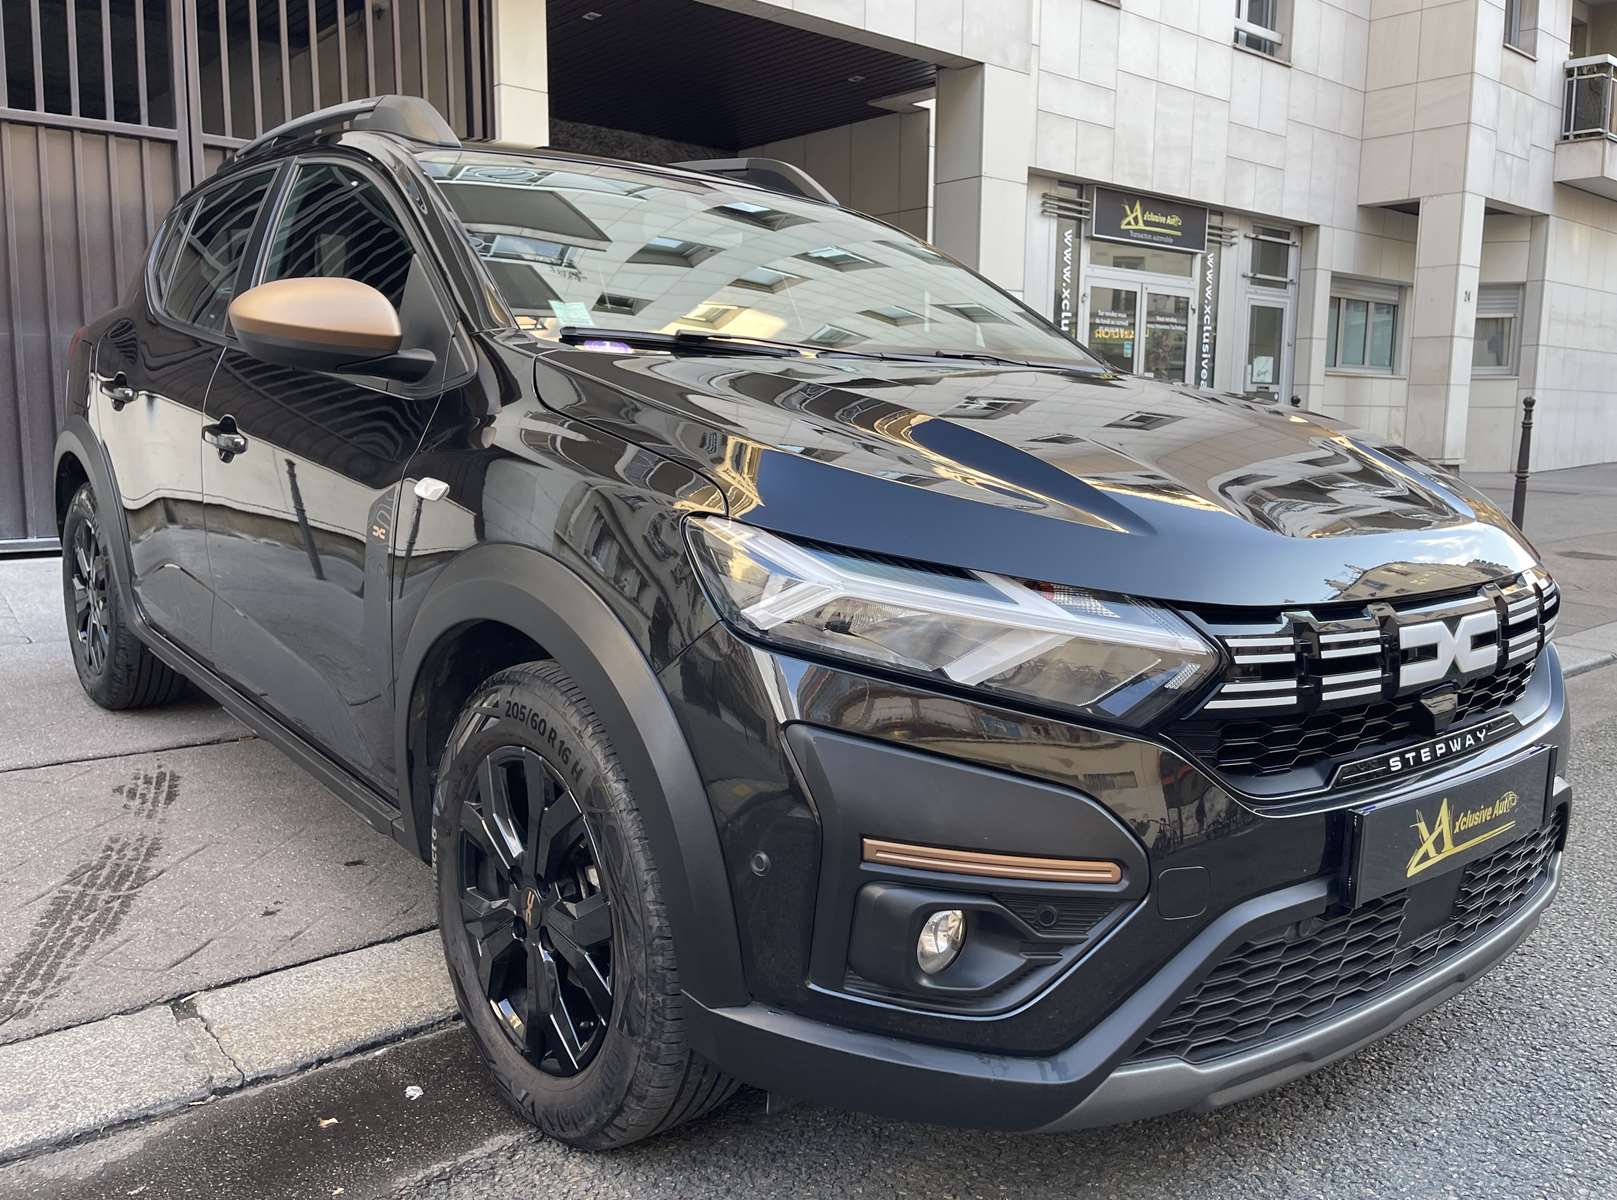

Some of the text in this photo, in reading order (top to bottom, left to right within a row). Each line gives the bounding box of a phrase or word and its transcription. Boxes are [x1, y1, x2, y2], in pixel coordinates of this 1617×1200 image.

[505, 700, 584, 783] 205/60 R 16 H
[1389, 729, 1486, 772] STEPWAY
